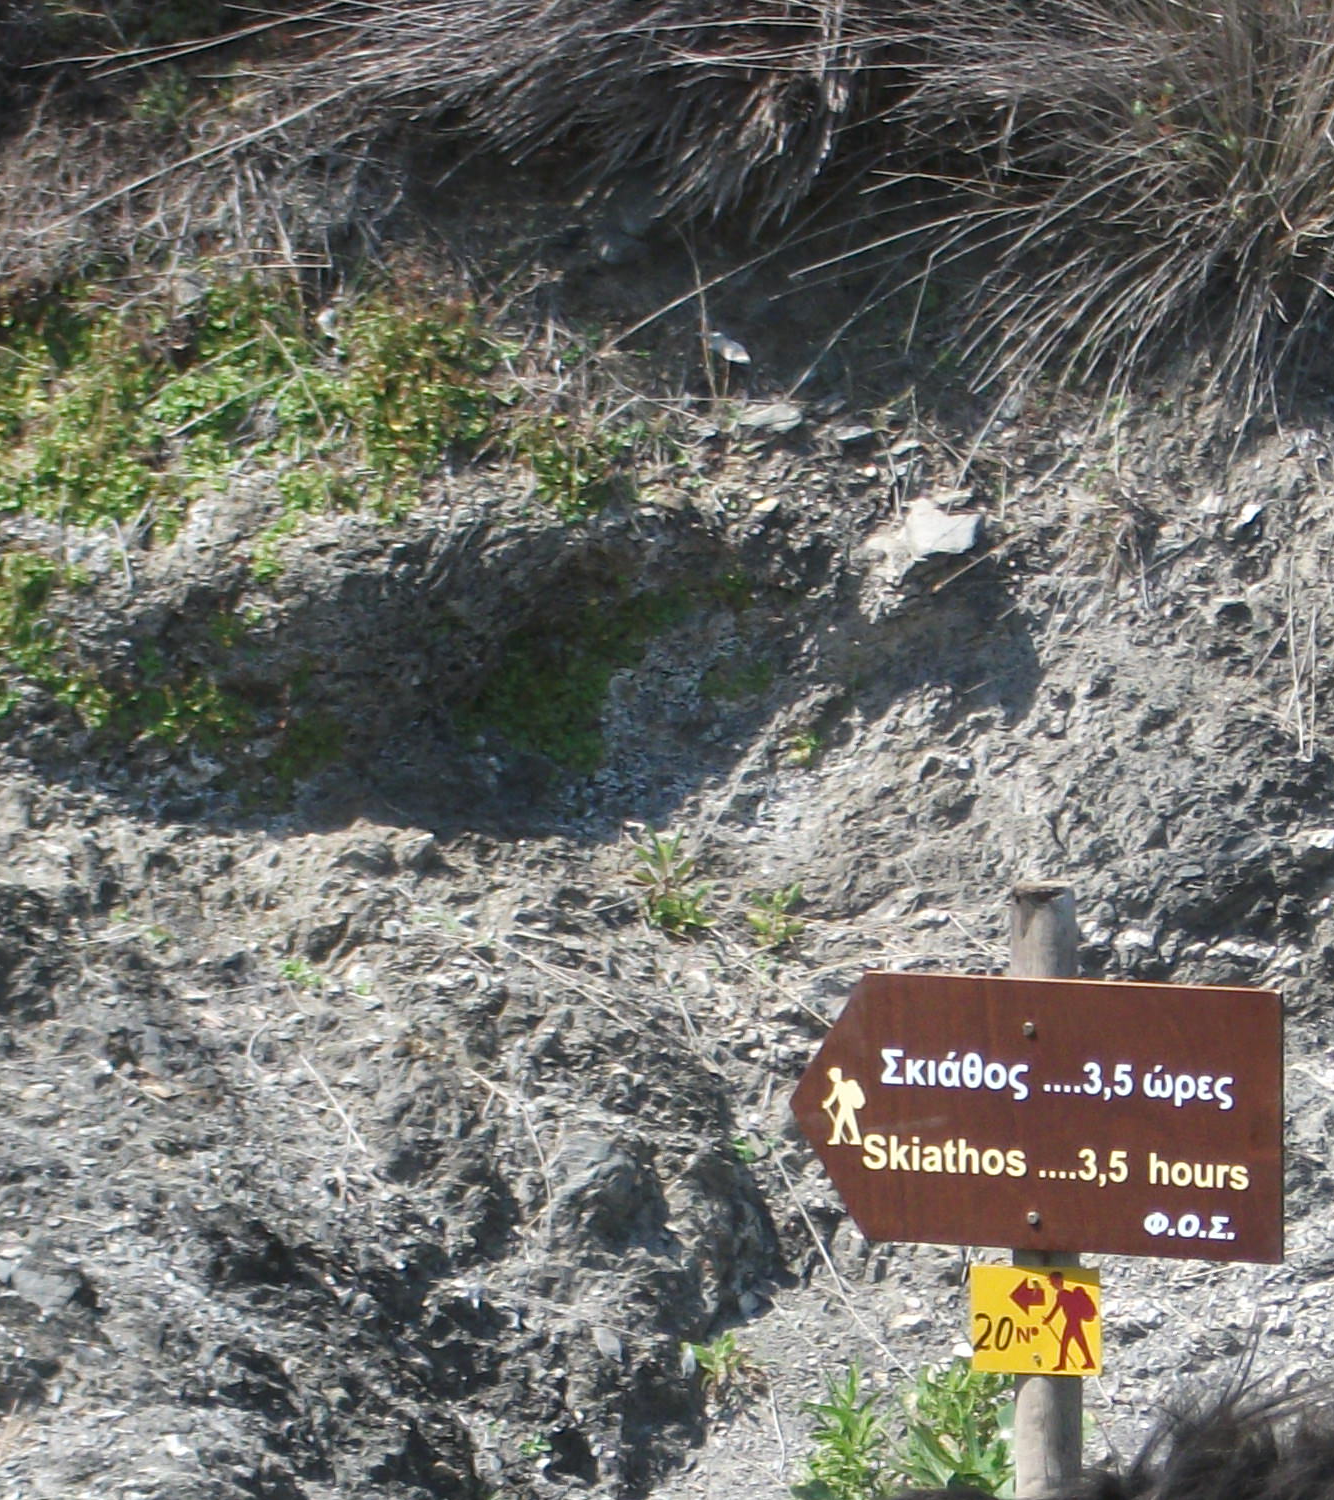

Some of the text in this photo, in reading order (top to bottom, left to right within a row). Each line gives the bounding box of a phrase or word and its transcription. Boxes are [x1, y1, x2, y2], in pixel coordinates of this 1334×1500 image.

[880, 1048, 1029, 1100] Σκιάθος
[1143, 1064, 1234, 1110] ώρες
[862, 1134, 1027, 1178] Skiathos
[1149, 1152, 1249, 1191] hours
